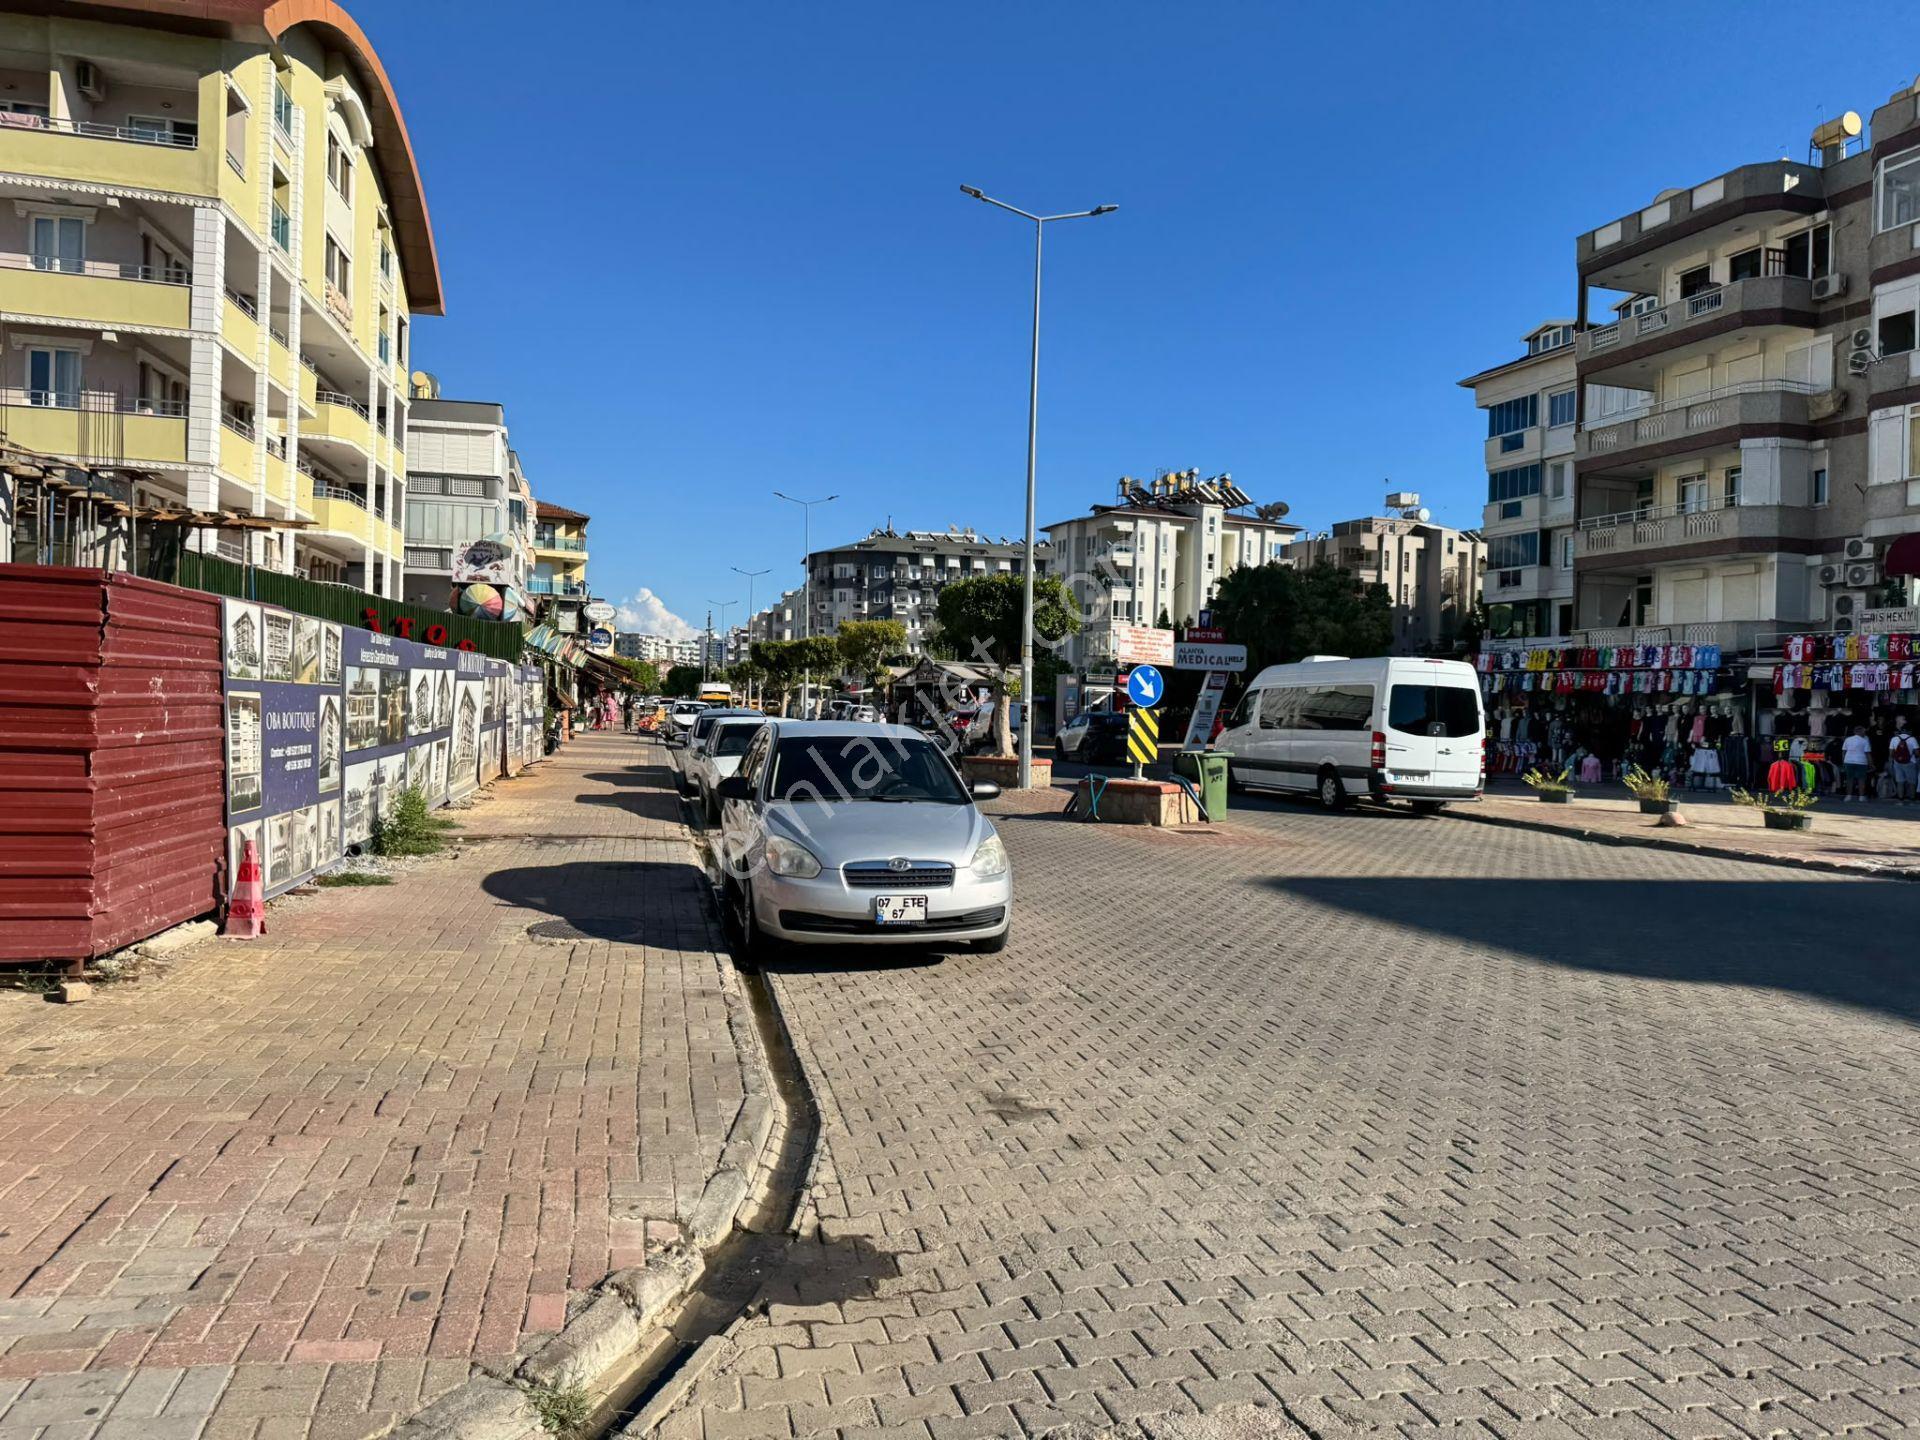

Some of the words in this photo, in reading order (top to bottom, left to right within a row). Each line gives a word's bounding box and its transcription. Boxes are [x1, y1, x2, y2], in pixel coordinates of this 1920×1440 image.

[1189, 631, 1223, 640] DOCTOR
[1179, 647, 1205, 655] ALANYA
[1177, 655, 1230, 666] MEDICAL
[266, 711, 281, 730] OBA
[282, 711, 316, 732] BOUTIQUE
[878, 898, 891, 908] 07
[903, 898, 925, 908] ETE
[892, 909, 905, 919] 67
